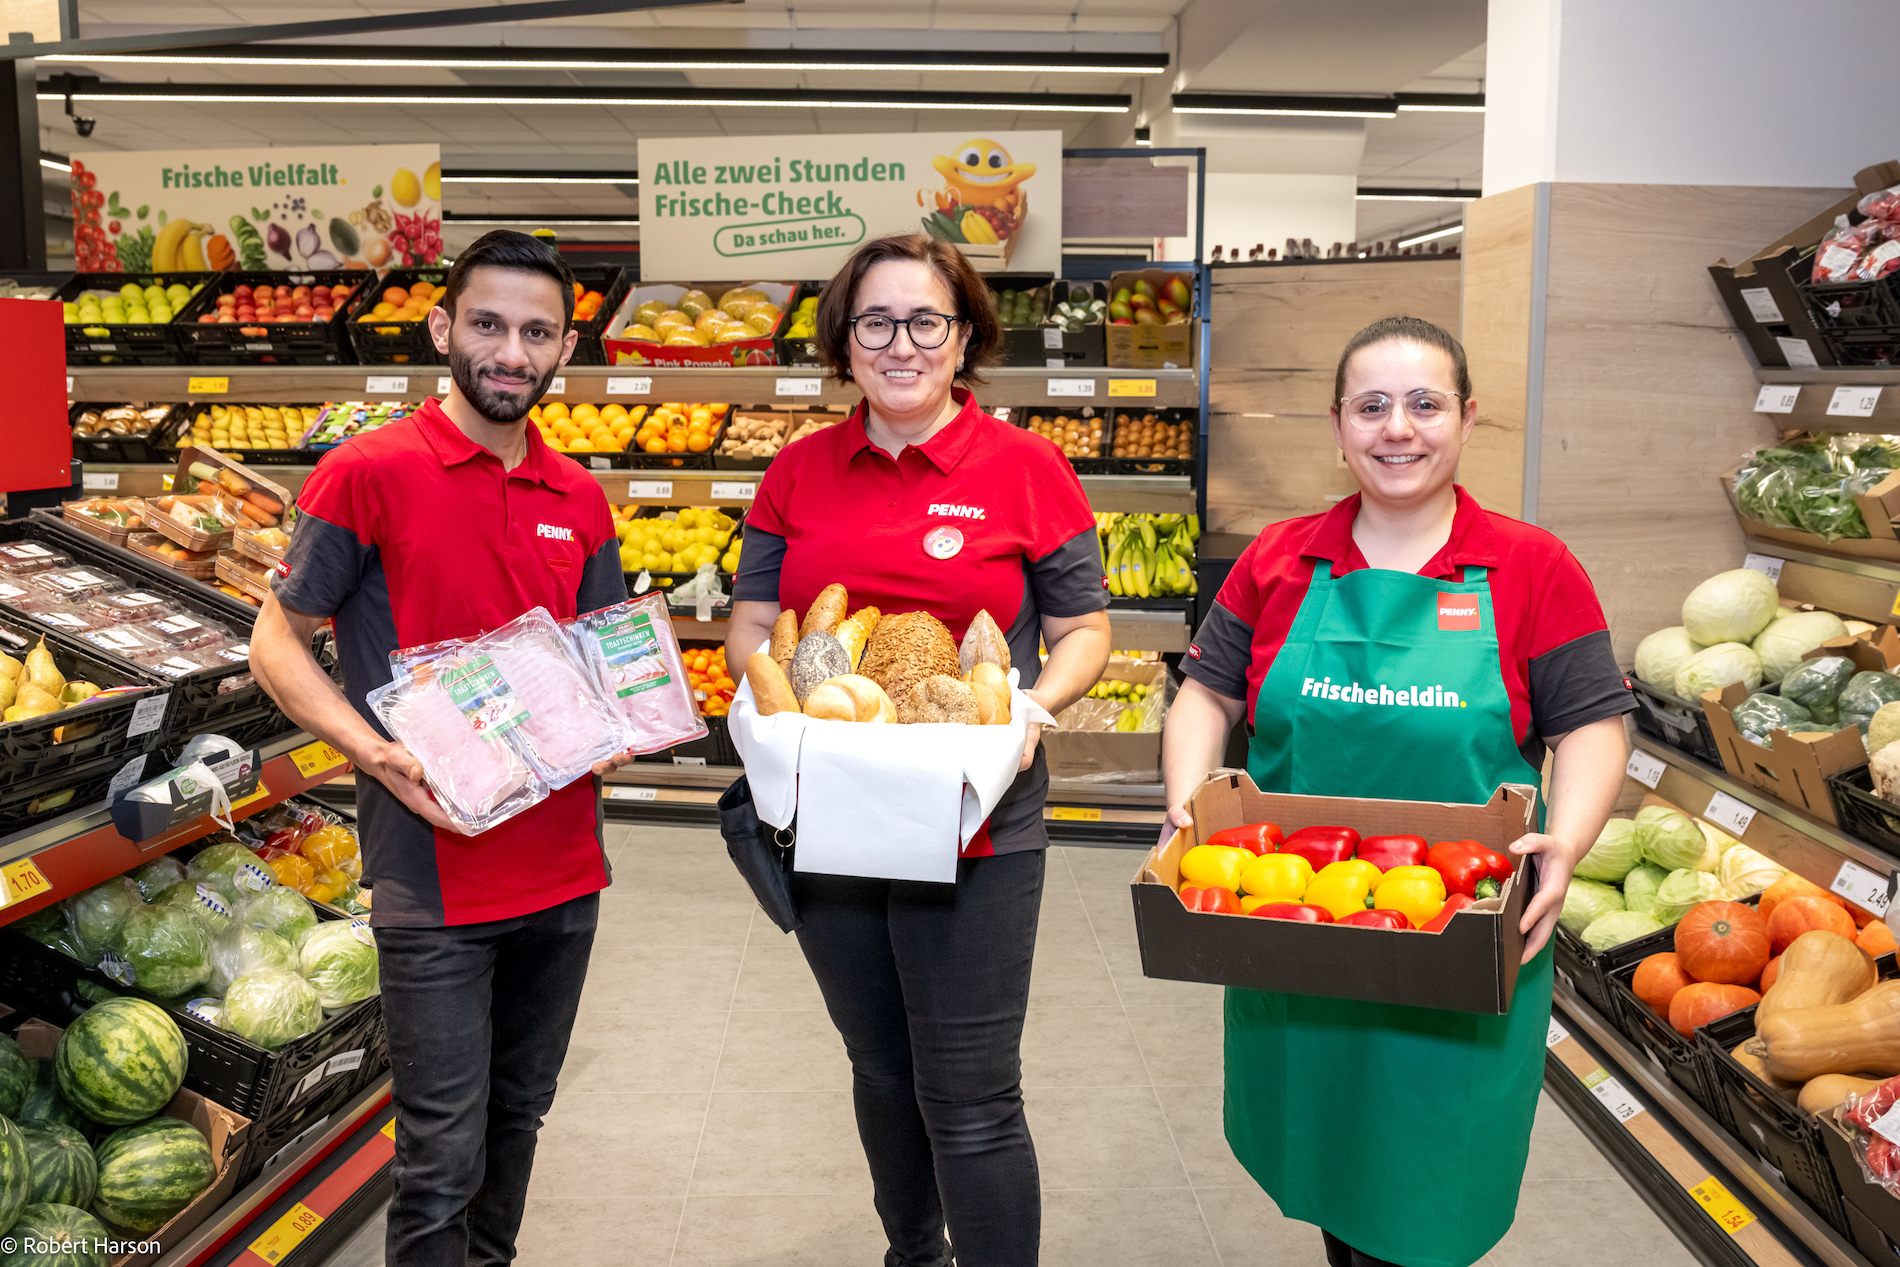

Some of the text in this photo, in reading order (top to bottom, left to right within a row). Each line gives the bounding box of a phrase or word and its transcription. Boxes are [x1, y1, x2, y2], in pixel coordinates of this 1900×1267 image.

[162, 162, 346, 189] Frische Vielfalt.
[653, 156, 906, 185] Alle zwei Stunden
[733, 224, 846, 248] Da schau her.
[654, 358, 731, 367] Pink Pomelo
[634, 383, 649, 391] 2.29
[804, 384, 819, 392] 1.79
[1077, 384, 1092, 393] 1.39
[1859, 396, 1875, 410] 1.29
[656, 486, 670, 495] 0.69
[738, 487, 753, 496] 4.99
[927, 503, 986, 520] PENNY.
[536, 523, 575, 542] PENNY.
[1439, 607, 1477, 617] PENNY.
[605, 629, 651, 650] TOASTSCHINKEN
[1300, 676, 1467, 708] Frischeheldin.
[1648, 767, 1660, 783] 1.19
[1733, 812, 1749, 829] 1.49
[11, 870, 40, 892] 1.70
[1867, 888, 1888, 908] 2.49
[1615, 1102, 1634, 1118] 1.79
[292, 1211, 317, 1232] 0.89
[1721, 1210, 1745, 1229] 1.54
